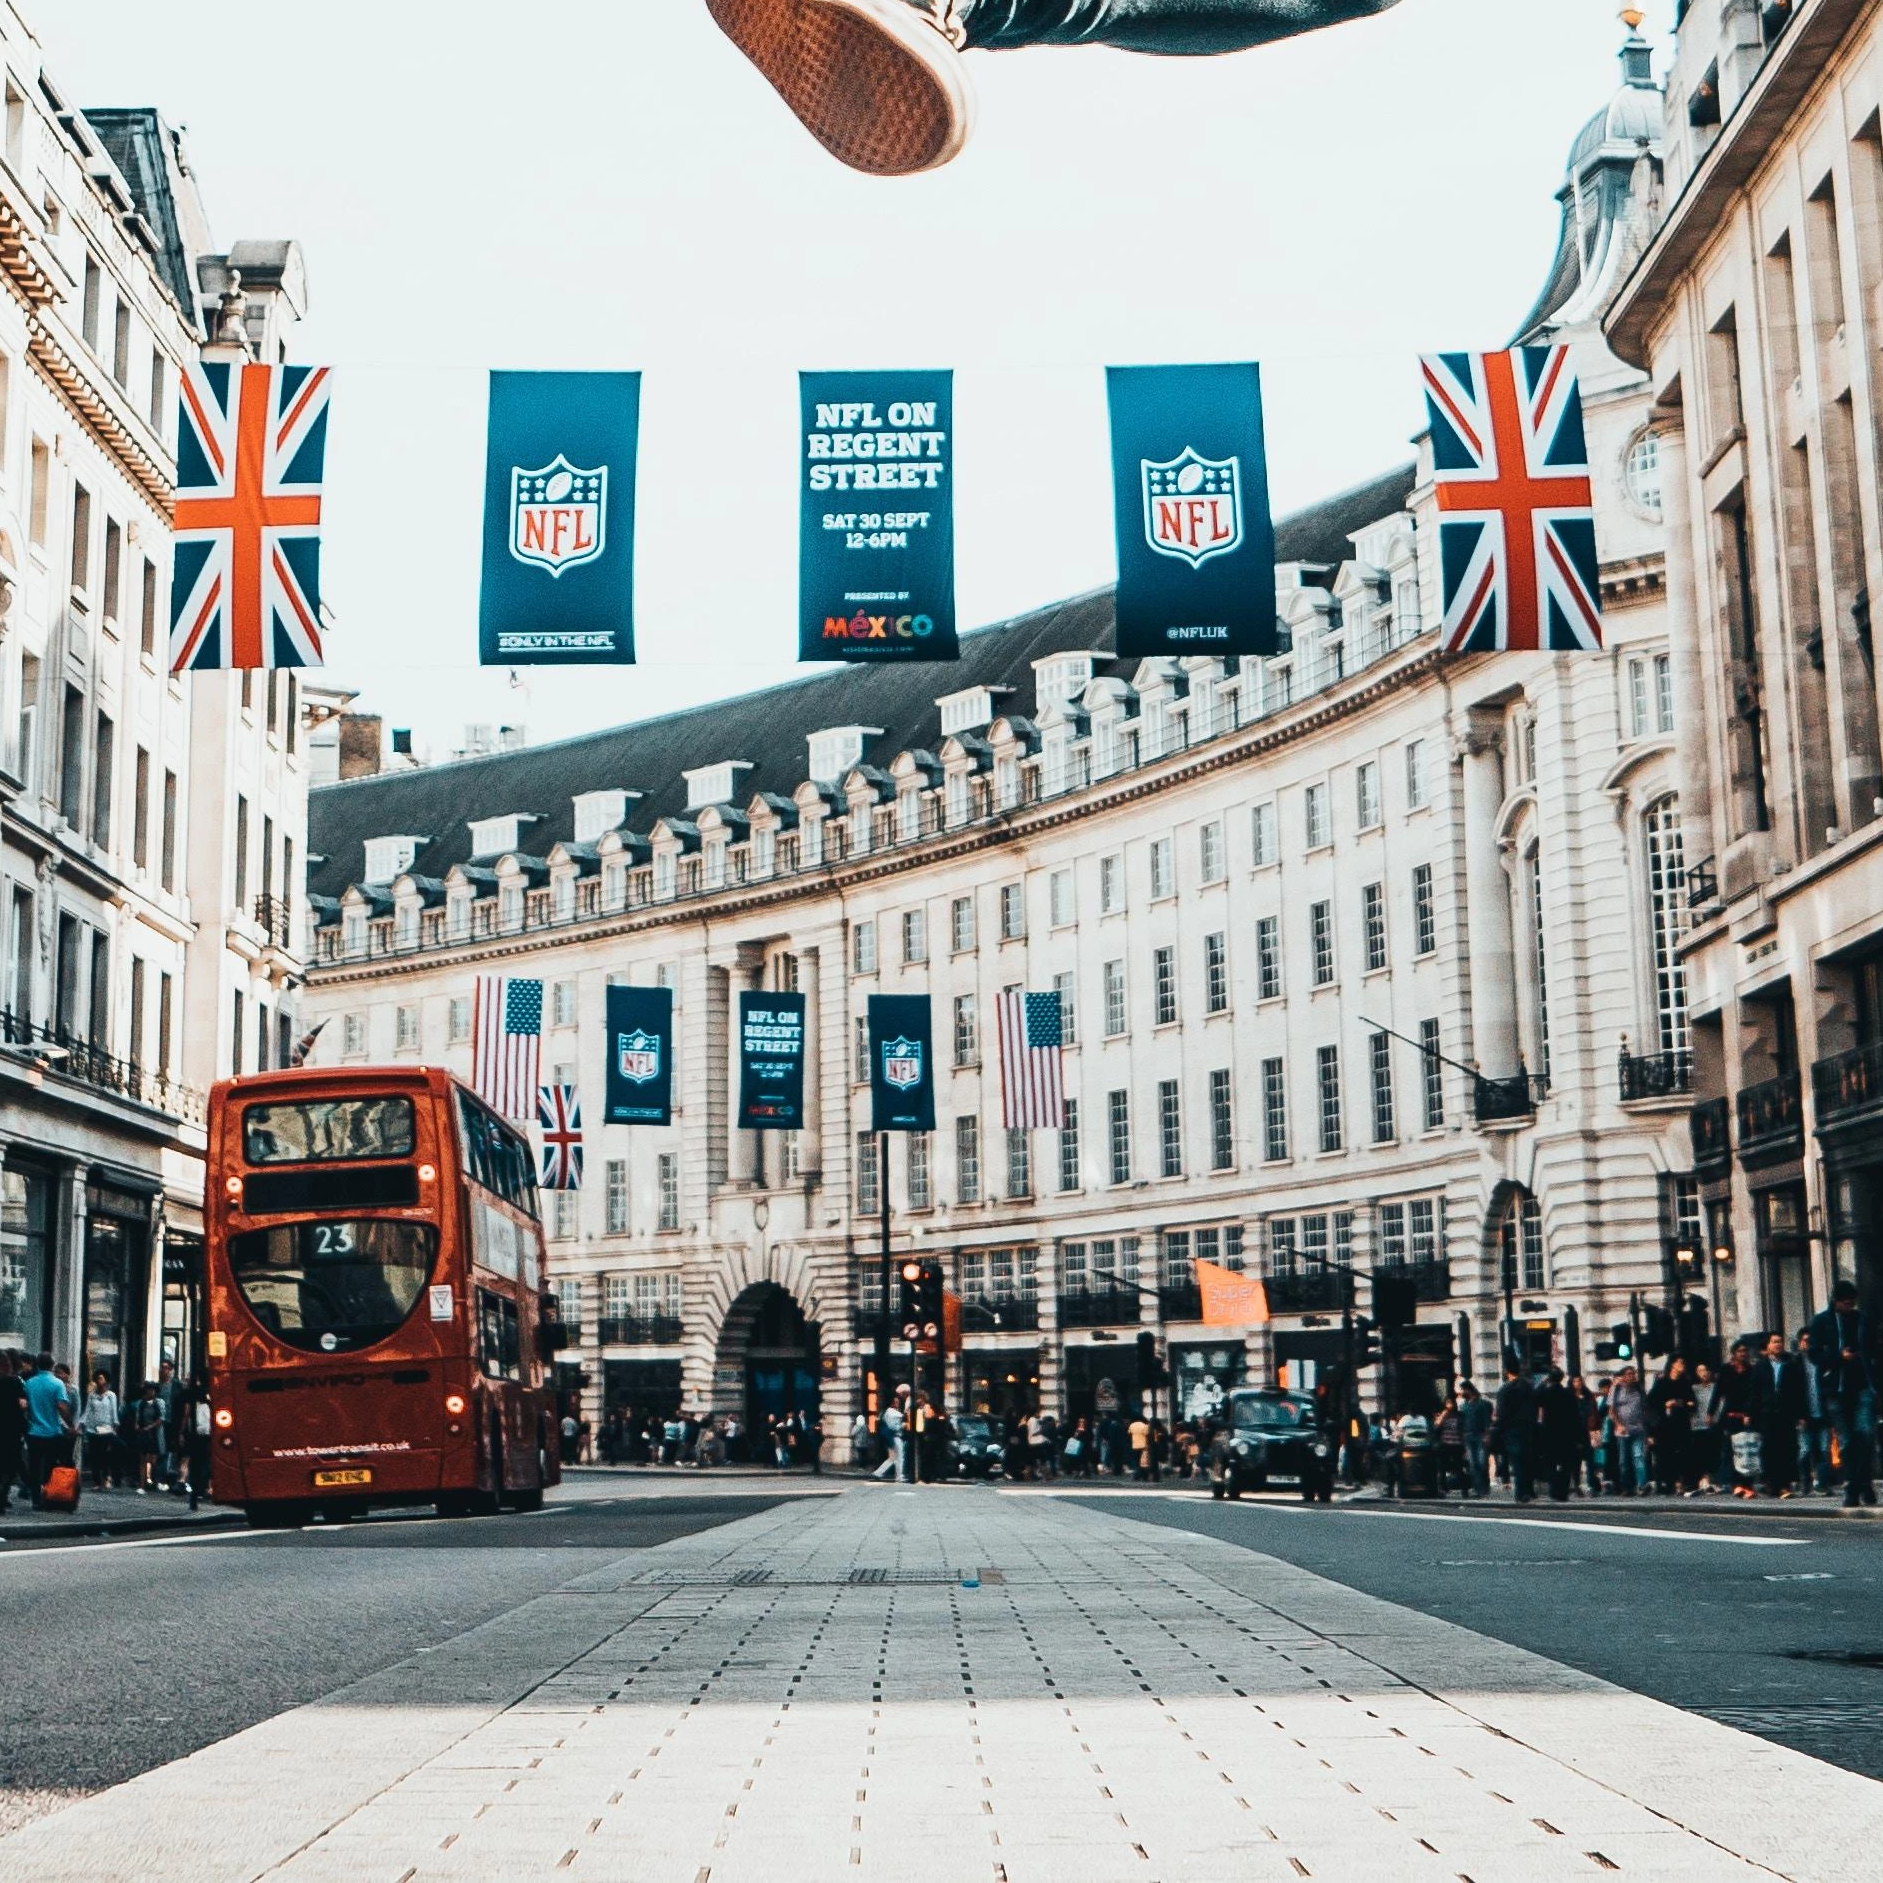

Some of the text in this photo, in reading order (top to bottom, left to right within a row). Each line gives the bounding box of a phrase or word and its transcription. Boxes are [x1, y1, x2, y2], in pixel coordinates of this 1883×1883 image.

[815, 401, 938, 429] NFL ON
[807, 431, 946, 460] REGENT
[809, 462, 944, 491] STREET
[822, 512, 931, 530] SAT 30 SEPT
[1158, 500, 1230, 548] NFL
[523, 509, 592, 557] NFL
[846, 532, 908, 549] 12-6PM
[499, 635, 614, 647] #ONLY IN THE NFL
[1166, 626, 1229, 639] @NFLUK
[744, 1039, 801, 1053] STREET
[623, 1052, 654, 1075] NFL
[887, 1059, 918, 1081] NFL
[315, 1224, 354, 1254] 23
